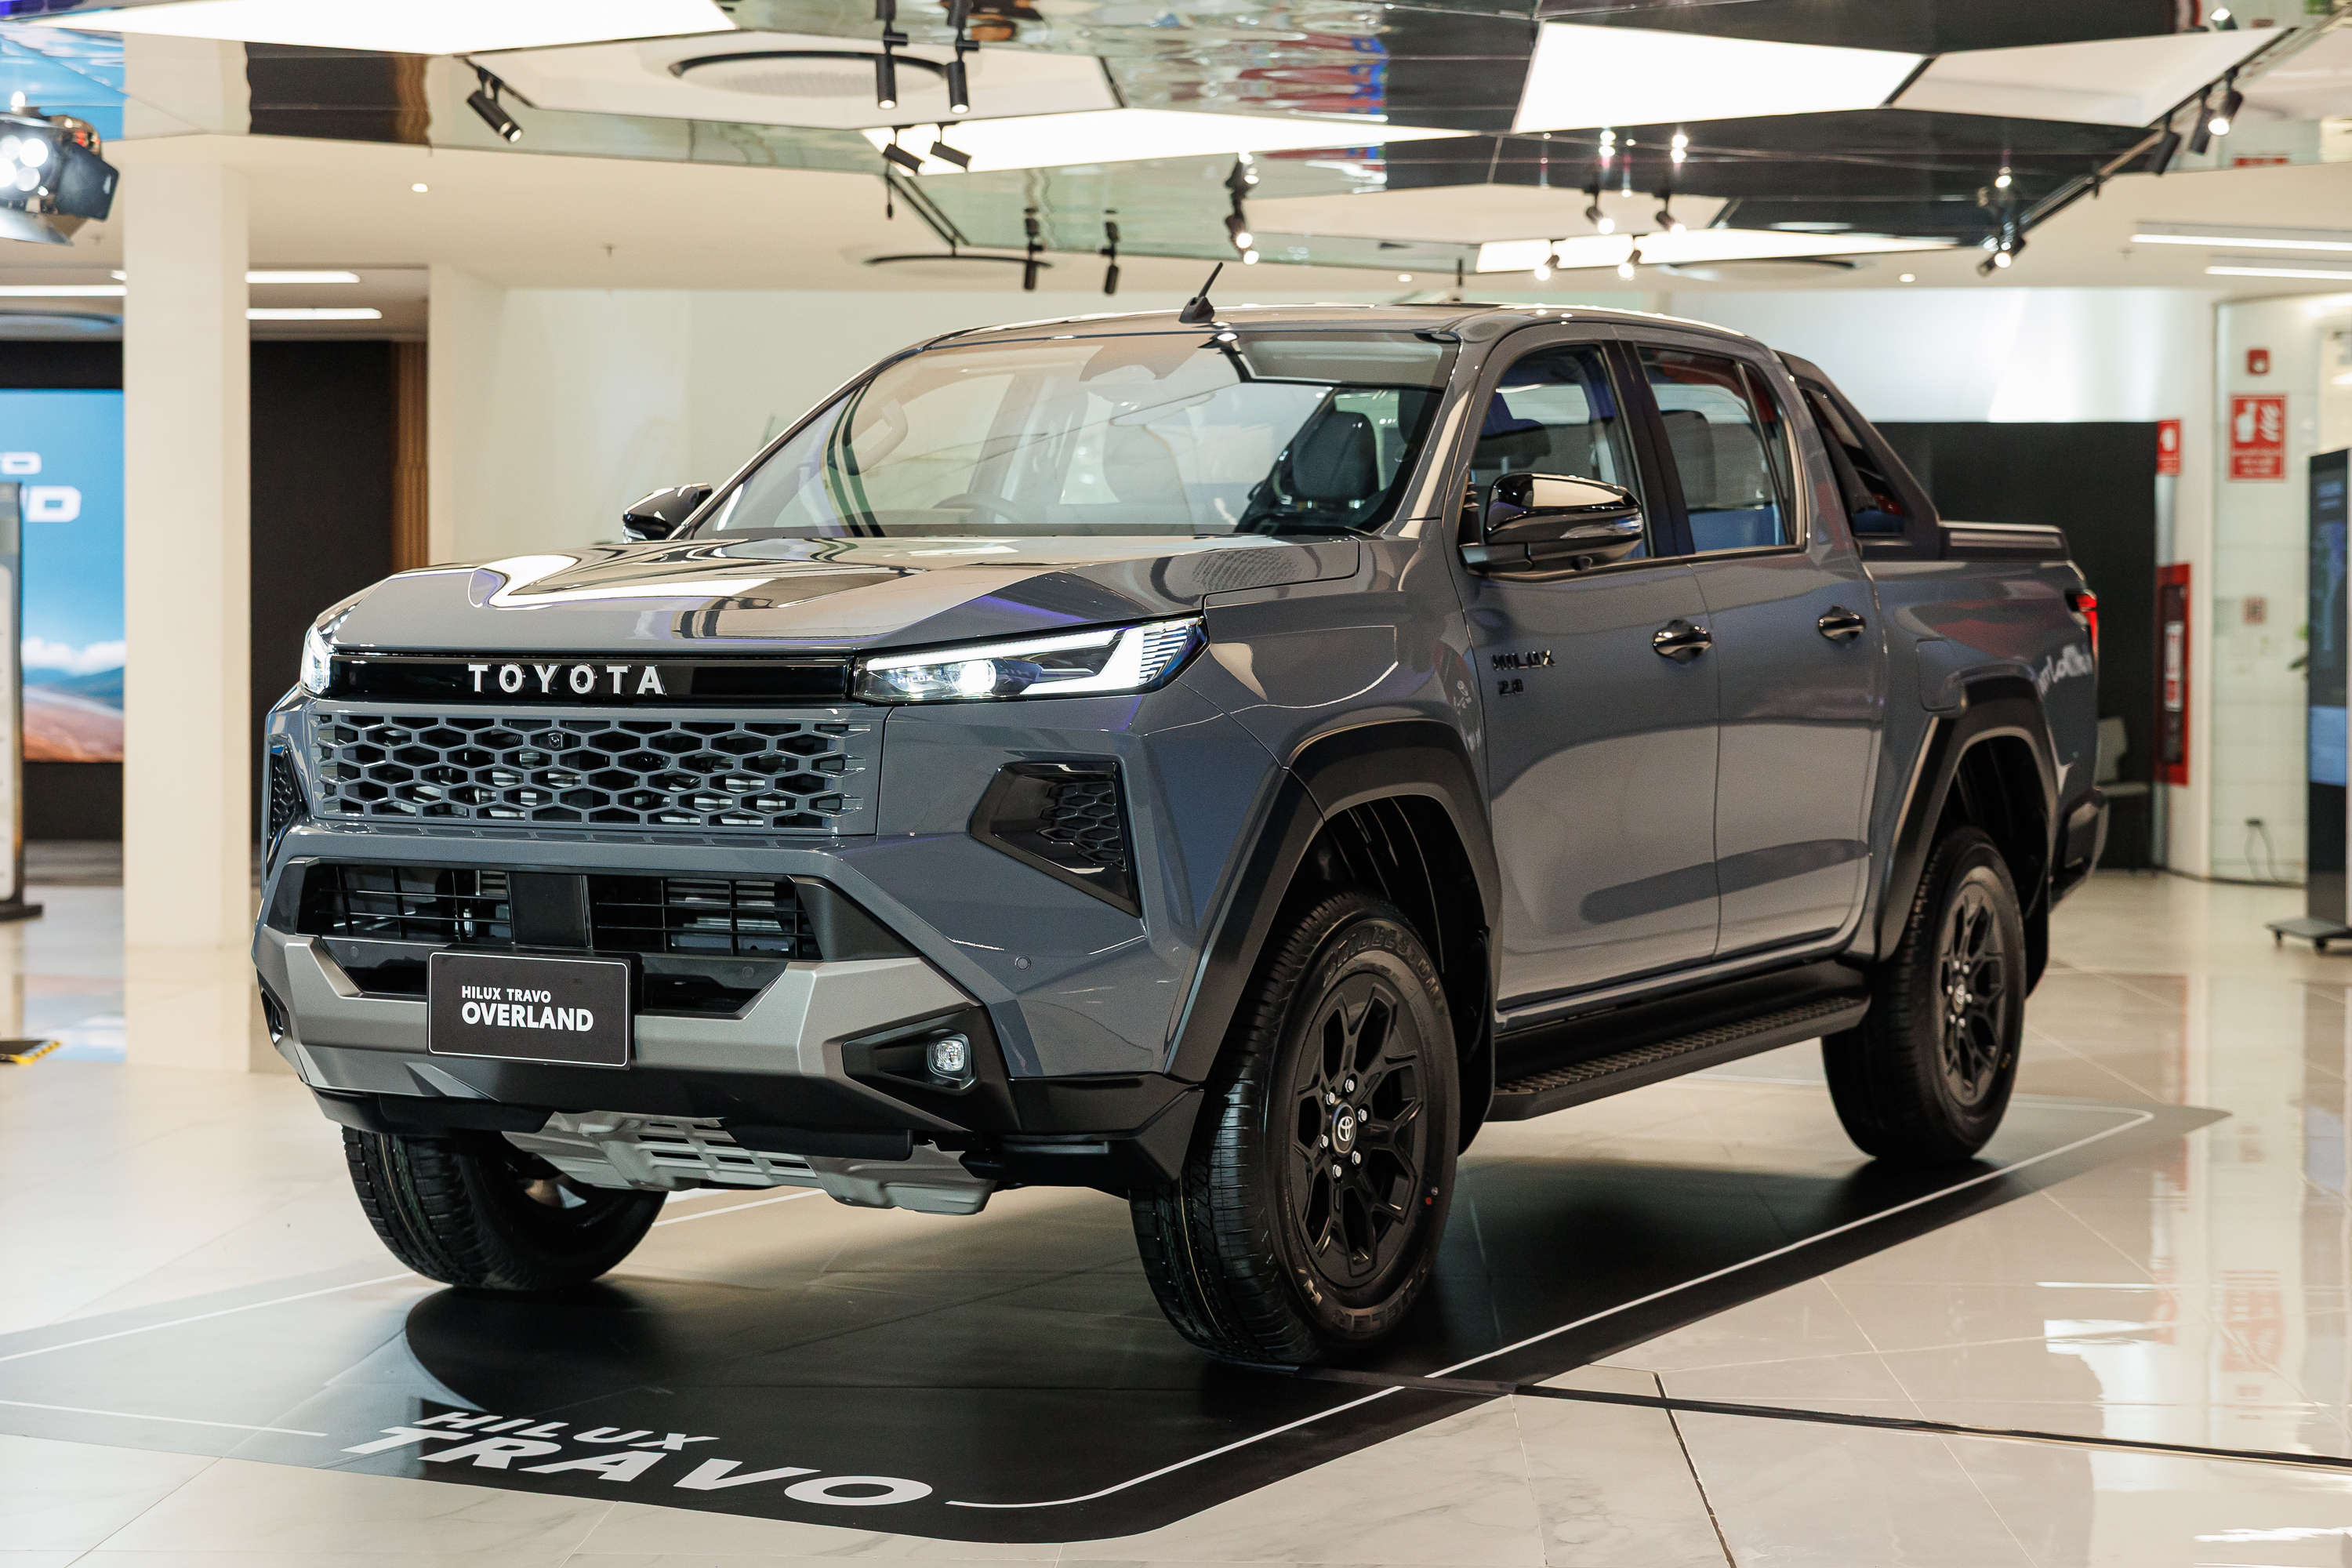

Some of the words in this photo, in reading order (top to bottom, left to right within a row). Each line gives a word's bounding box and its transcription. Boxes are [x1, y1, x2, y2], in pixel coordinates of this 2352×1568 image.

[1491, 650, 1556, 670] HILUX
[468, 662, 667, 696] TOYOTA
[896, 674, 935, 684] HILUX
[1322, 927, 1446, 1014] BRIDGESTONE
[461, 985, 501, 1000] HILUX
[506, 989, 551, 1004] TRAVO
[461, 1001, 593, 1032] OVERLAND
[412, 1411, 720, 1450] HILUX
[340, 1426, 933, 1506] TRAVO
